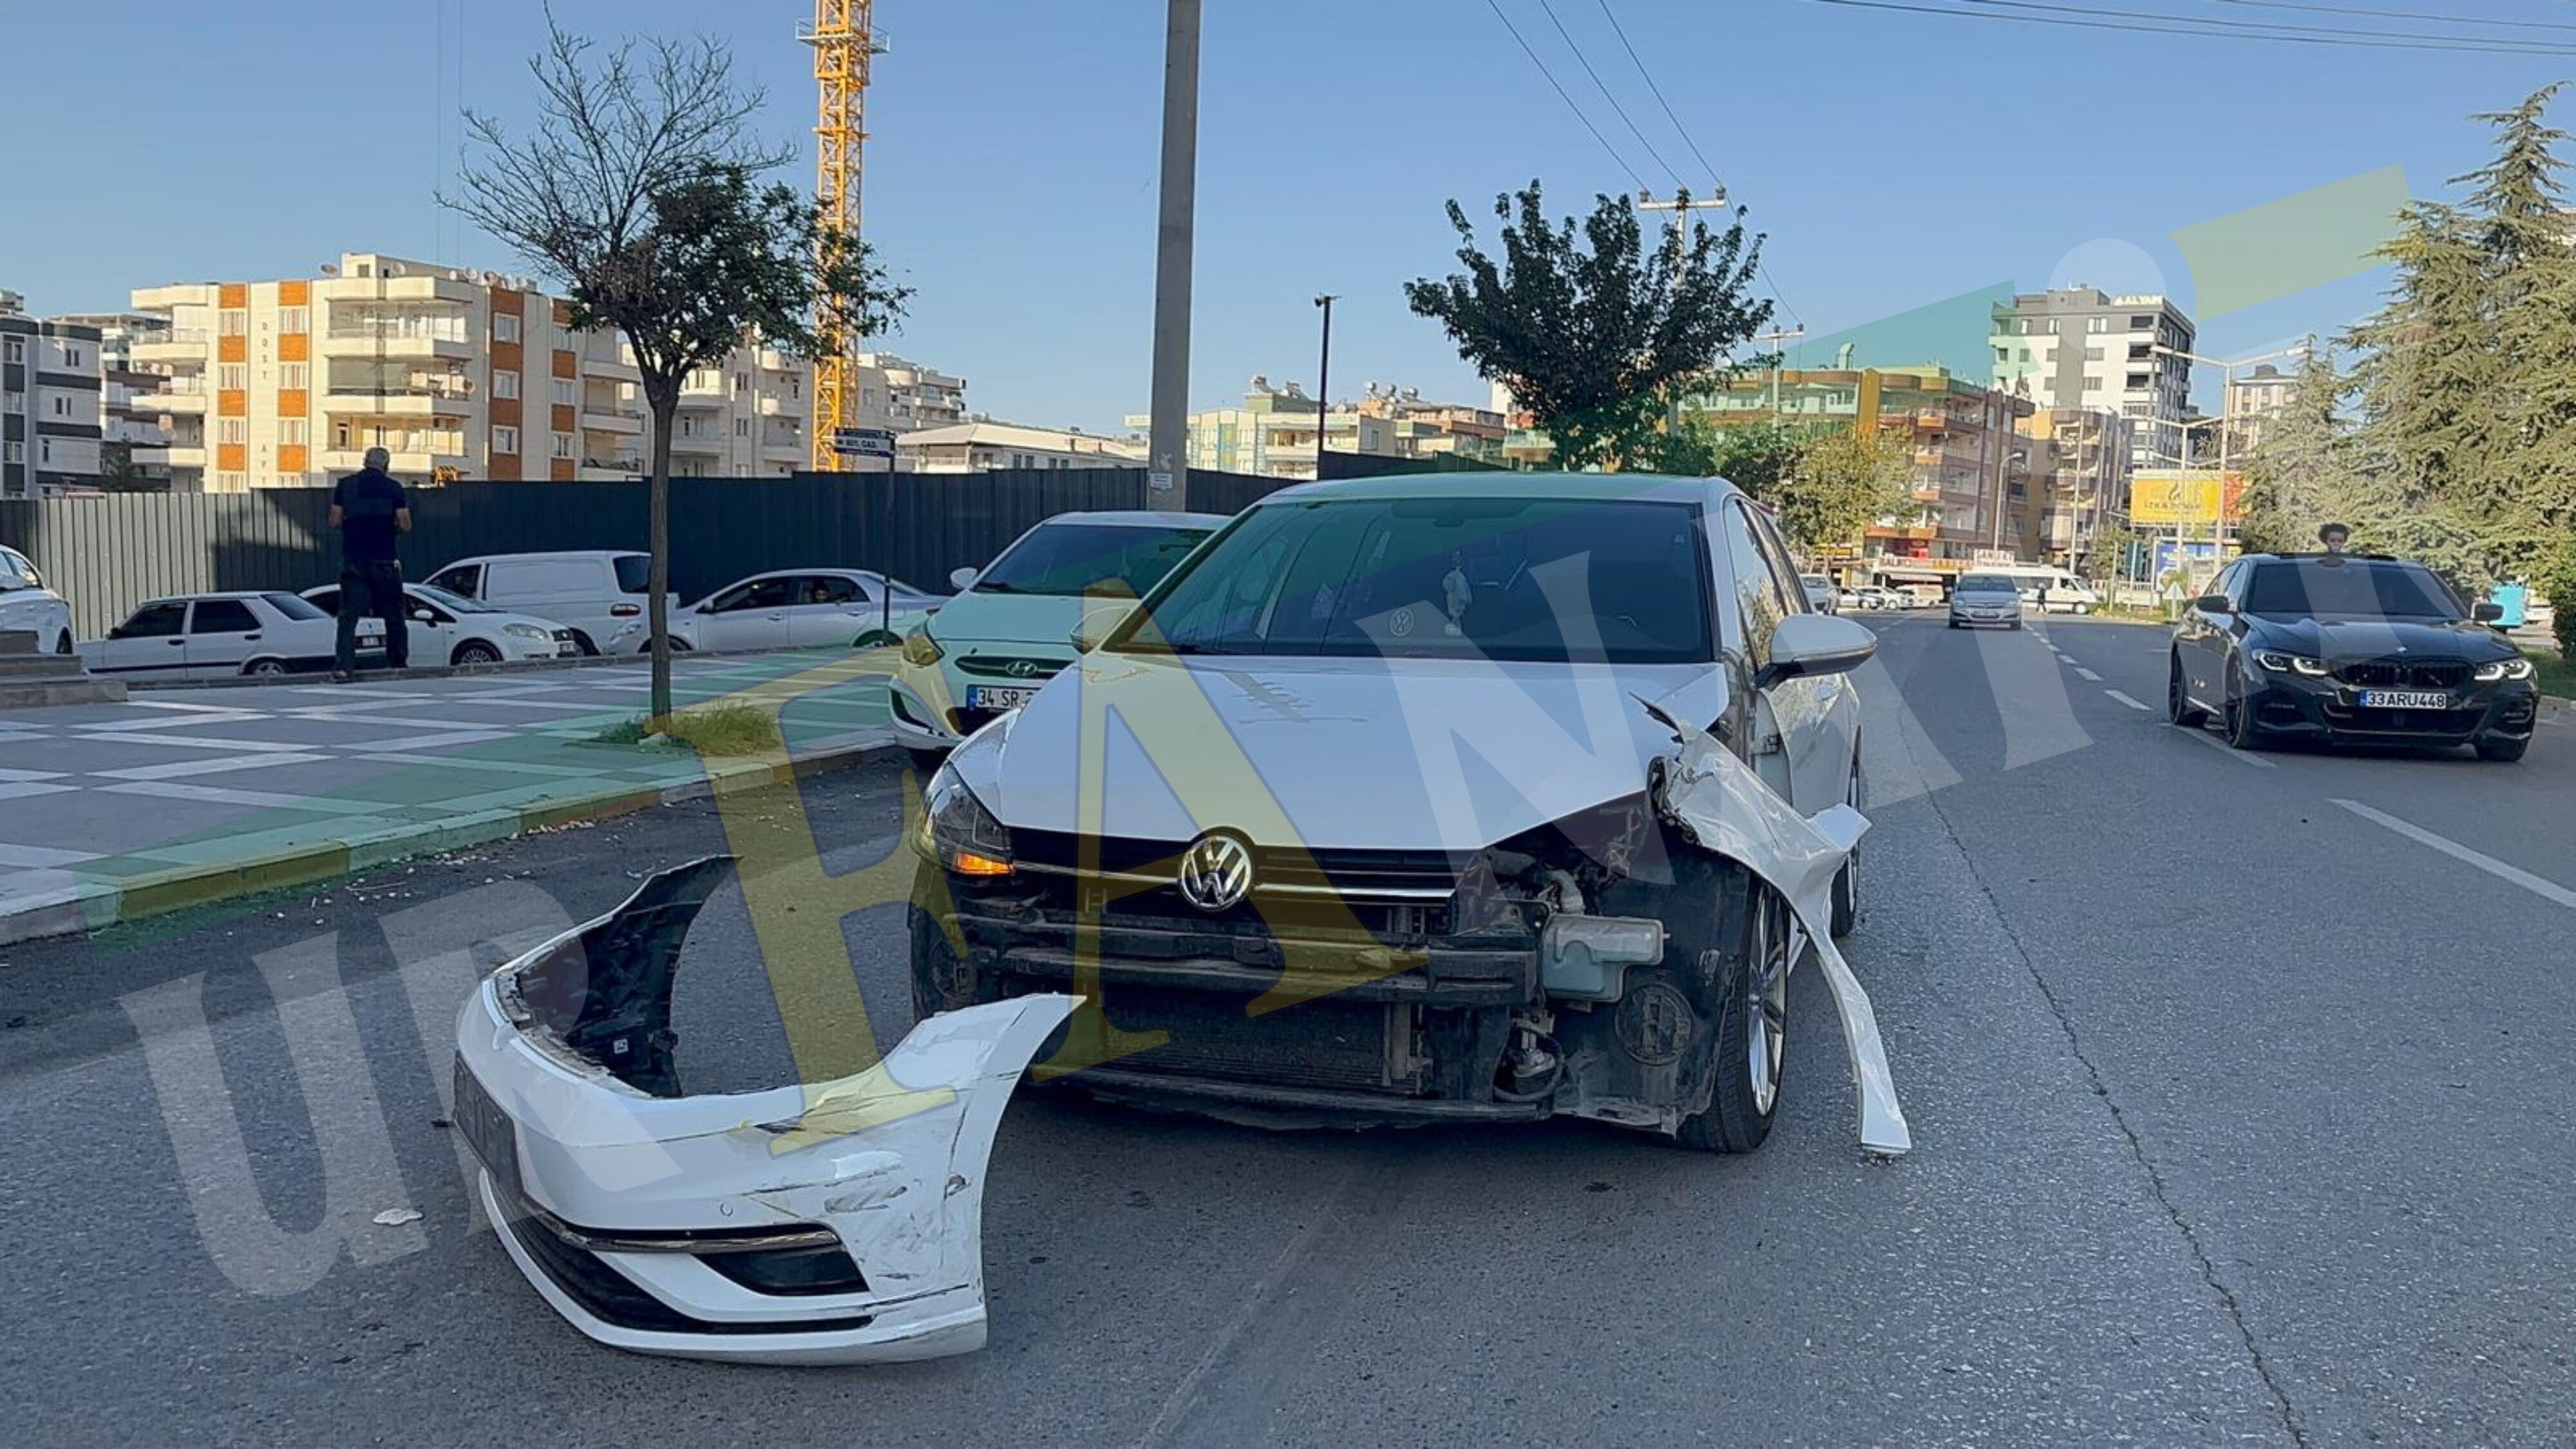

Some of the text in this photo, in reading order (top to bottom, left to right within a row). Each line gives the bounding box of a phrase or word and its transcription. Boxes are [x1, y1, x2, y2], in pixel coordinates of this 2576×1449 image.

[978, 689, 995, 706] 34
[1001, 690, 1019, 708] SR
[2368, 692, 2445, 707] 33ARU448
